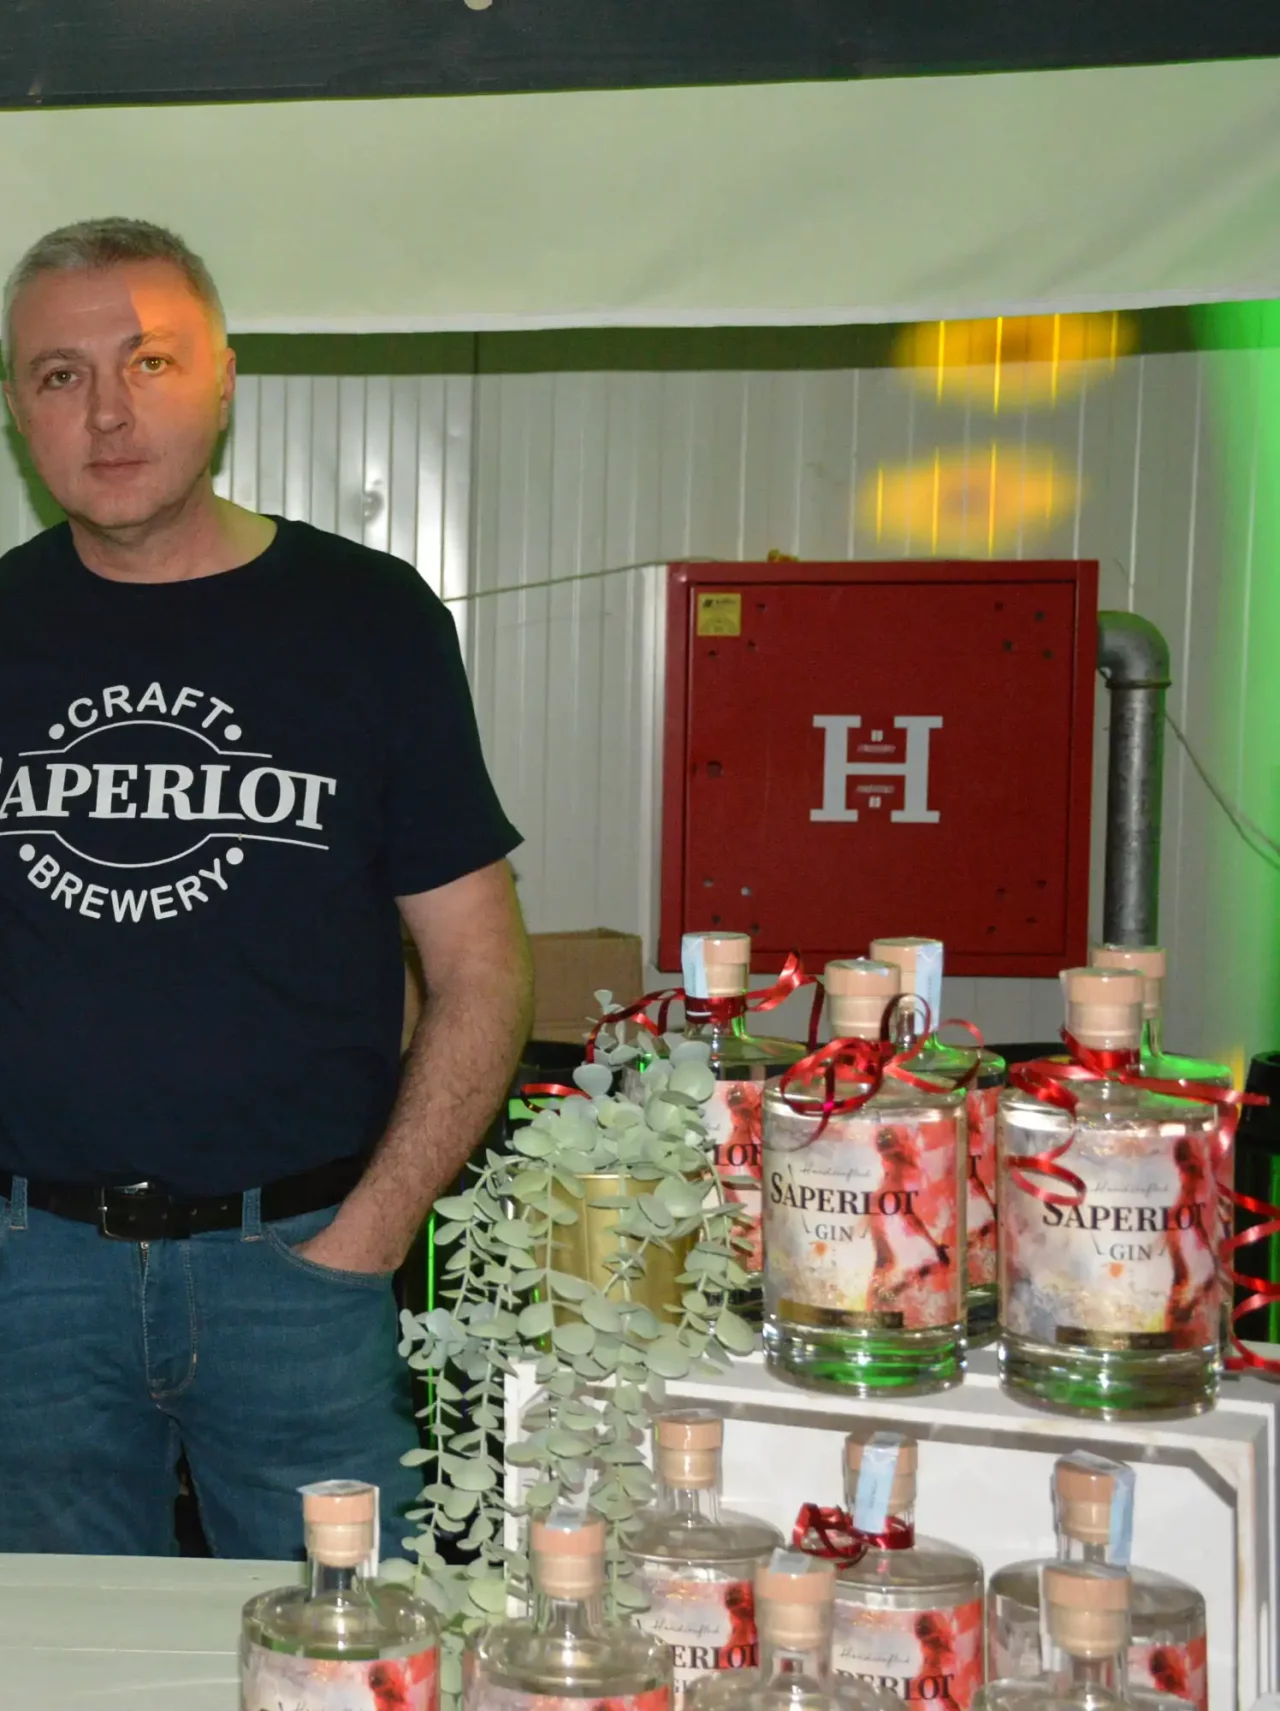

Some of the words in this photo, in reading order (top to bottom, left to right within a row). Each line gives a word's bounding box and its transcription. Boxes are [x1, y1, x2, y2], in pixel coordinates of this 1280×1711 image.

[68, 682, 234, 728] CRAFT
[810, 715, 943, 823] H
[27, 854, 228, 922] BREWERY
[770, 1172, 919, 1216] SAPERLOT
[815, 1223, 853, 1241] GIN
[1042, 1201, 1206, 1232] SAPERLOT
[1110, 1243, 1151, 1260] GIN
[671, 1644, 759, 1669] ERLOT
